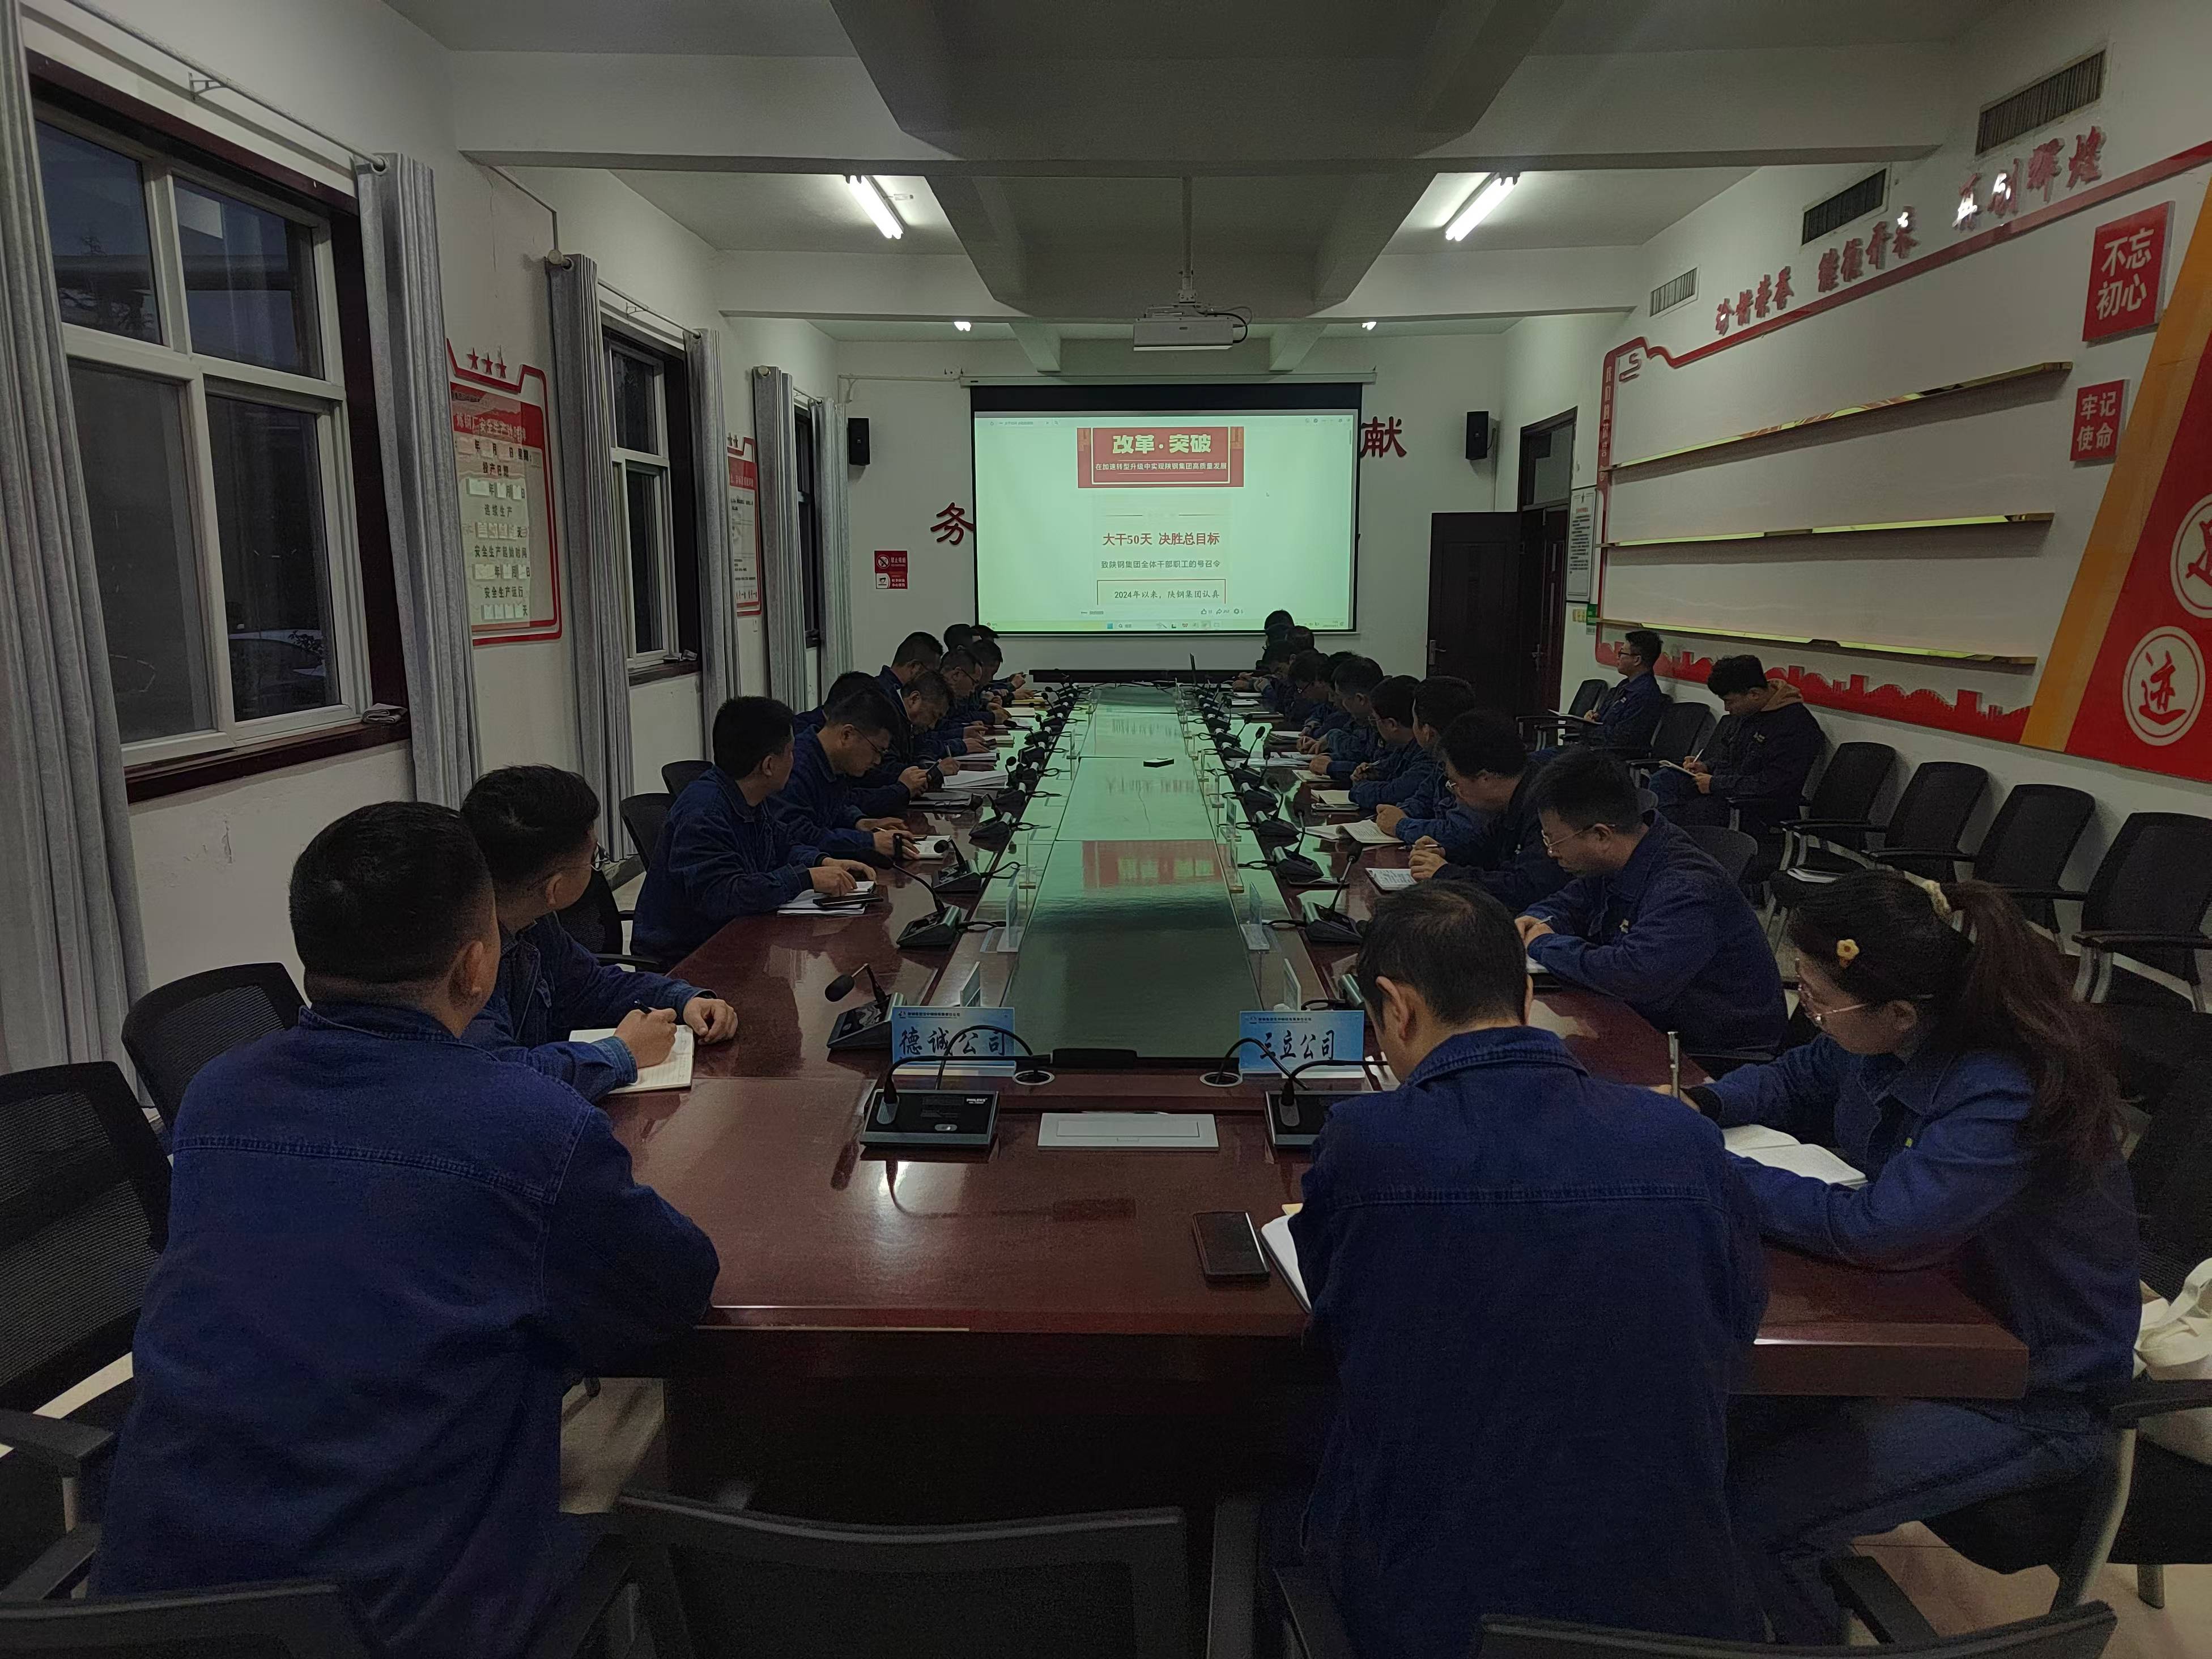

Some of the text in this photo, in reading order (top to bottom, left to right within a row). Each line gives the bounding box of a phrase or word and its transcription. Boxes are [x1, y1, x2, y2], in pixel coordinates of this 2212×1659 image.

[2102, 228, 2154, 276] 不忘
[2096, 274, 2147, 320] 初心
[2081, 392, 2116, 420] 牢记
[1360, 416, 1407, 458] 献
[2076, 423, 2113, 453] 使命
[1095, 462, 1227, 471] 在加速转型升级中实现陕钢集团高质量发展
[930, 502, 974, 546] 务
[1103, 531, 1220, 546] 大干50天 决胜总目标
[1101, 560, 1221, 569] 致陕钢集团全体干部职工的号召令
[484, 586, 524, 599] 安全生产运行
[899, 1026, 1005, 1056] 德诚公司
[1260, 1030, 1334, 1060] 三立公司
